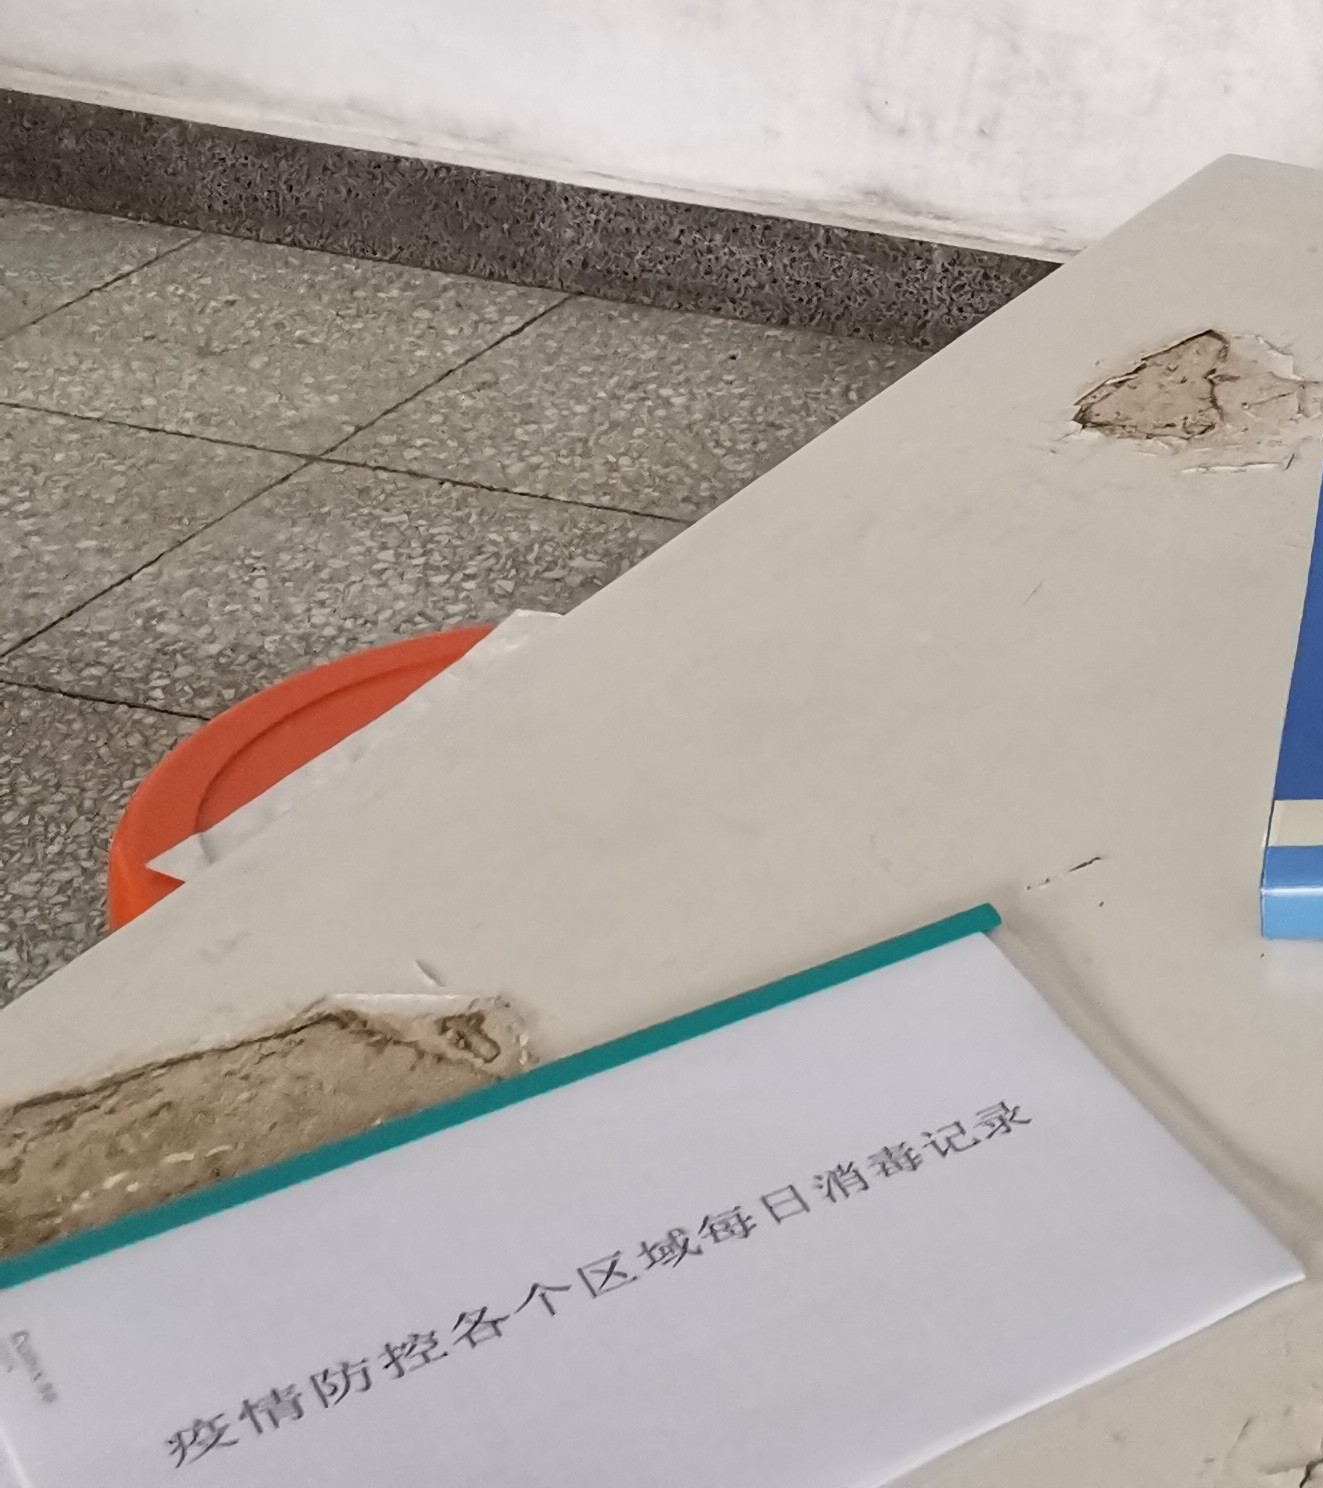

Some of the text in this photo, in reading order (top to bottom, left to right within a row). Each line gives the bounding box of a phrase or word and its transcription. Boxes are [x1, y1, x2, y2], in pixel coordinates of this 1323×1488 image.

[165, 1098, 1033, 1469] 疫情防控各个区域每日消毒记录
